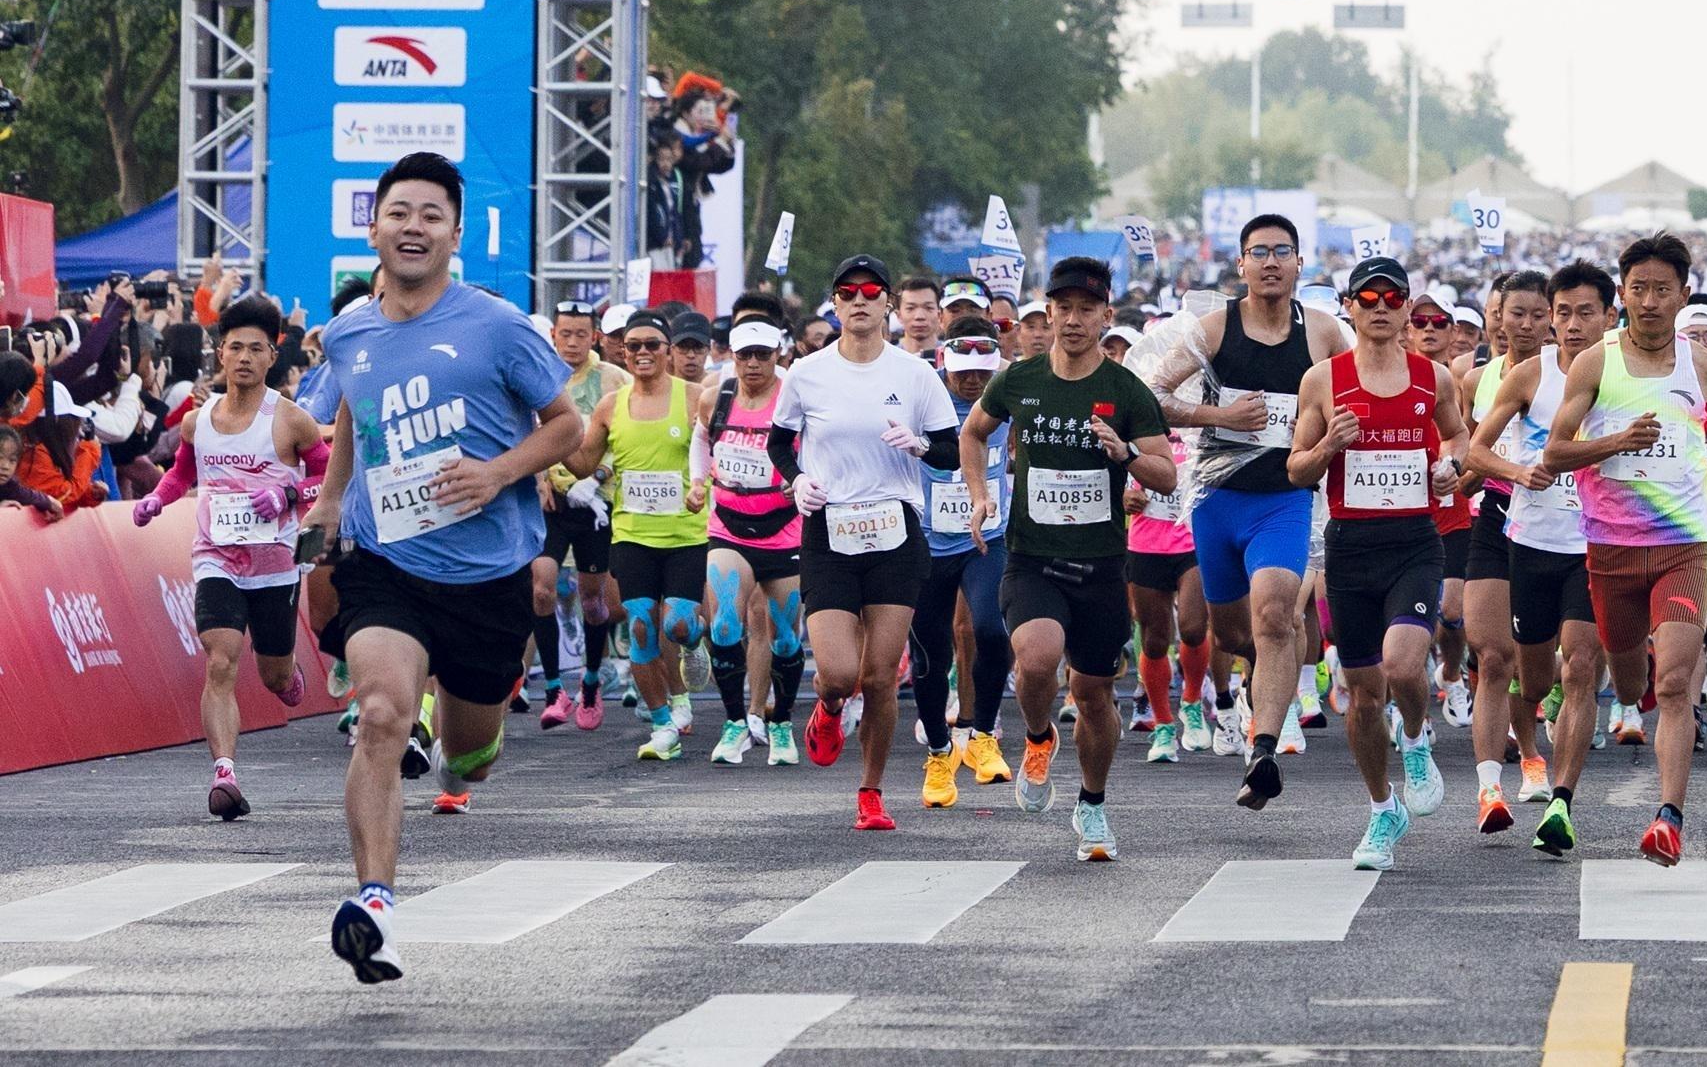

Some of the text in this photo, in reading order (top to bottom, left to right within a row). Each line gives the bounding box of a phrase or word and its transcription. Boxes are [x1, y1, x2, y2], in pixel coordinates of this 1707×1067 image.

[362, 59, 408, 77] ANTA
[398, 398, 467, 452] HUN
[1033, 414, 1093, 433] 中国老兵
[203, 453, 257, 467] saucony
[718, 459, 767, 477] A10171
[1353, 472, 1422, 487] A10192
[628, 485, 677, 498] A10586
[1036, 489, 1104, 504] A10858
[836, 516, 899, 537] A20119
